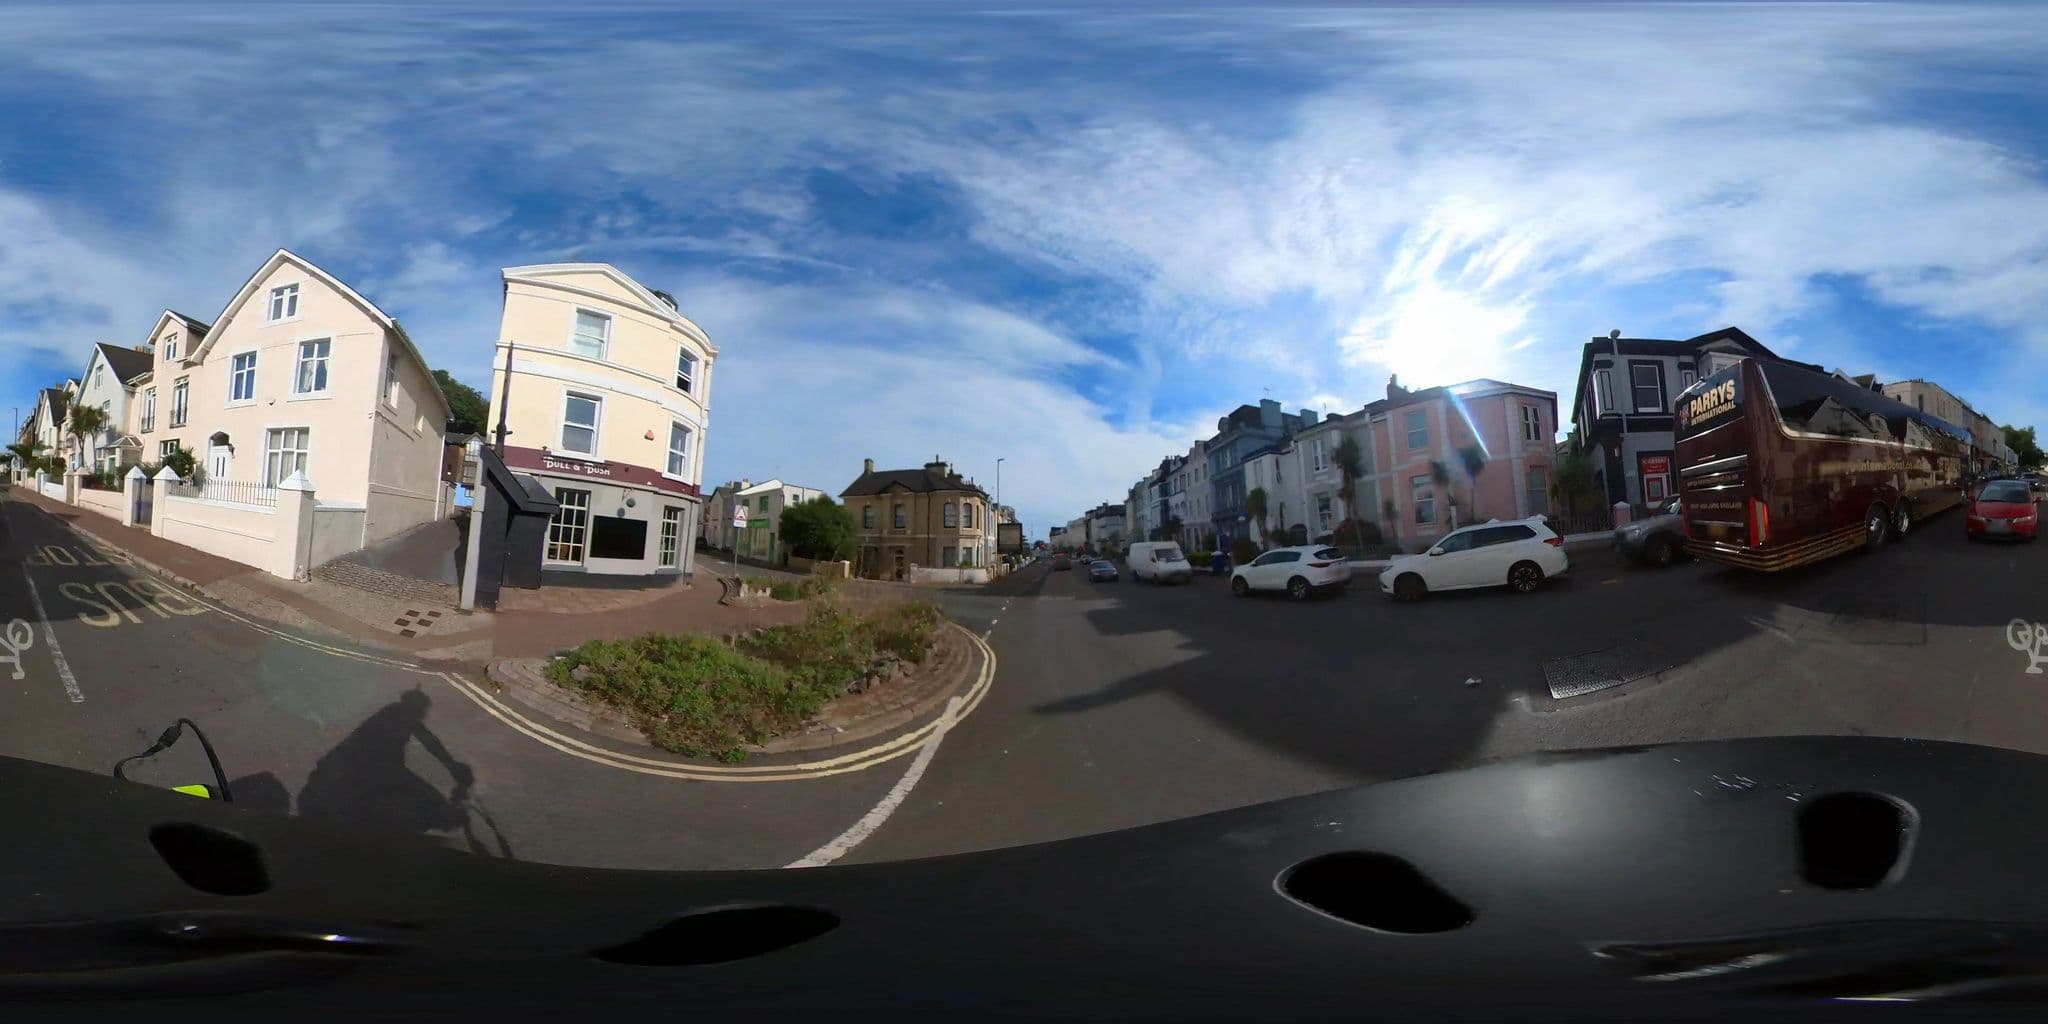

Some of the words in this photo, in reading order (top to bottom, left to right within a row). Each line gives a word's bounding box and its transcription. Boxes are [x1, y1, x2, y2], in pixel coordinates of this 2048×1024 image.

[1690, 379, 1735, 418] PARRYS
[1691, 400, 1736, 426] INTERNATIONAL
[58, 579, 209, 627] BUS
